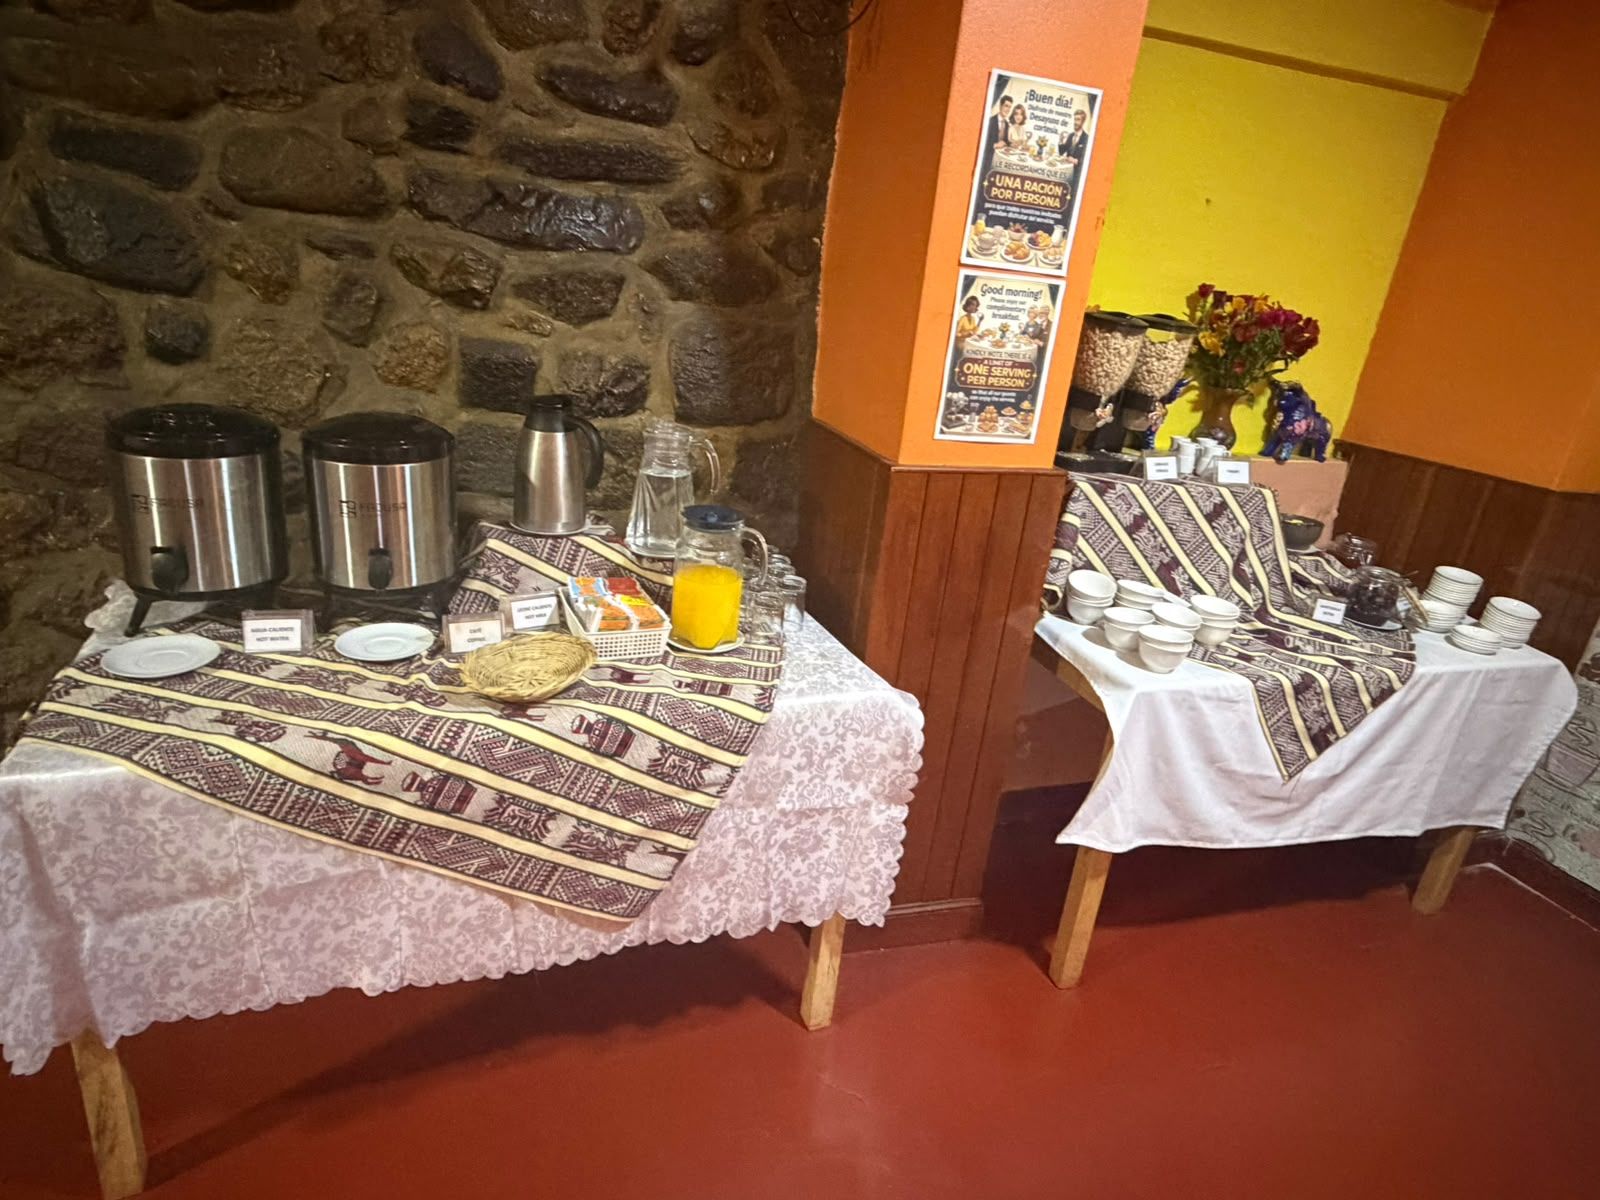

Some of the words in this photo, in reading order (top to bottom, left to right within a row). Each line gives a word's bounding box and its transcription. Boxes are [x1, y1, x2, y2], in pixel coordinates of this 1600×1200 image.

[1024, 89, 1054, 105] ¡Buen
[1055, 94, 1074, 109] día!
[995, 174, 1022, 190] UNA
[1023, 180, 1063, 197] RACIÓN
[991, 187, 1013, 200] POR
[1014, 191, 1061, 208] PERSONA
[981, 283, 1004, 297] Good
[1005, 287, 1043, 302] morning!
[963, 362, 990, 376] ONE
[990, 366, 1032, 380] SERVING
[966, 375, 986, 386] PER
[987, 377, 1026, 388] PERSON
